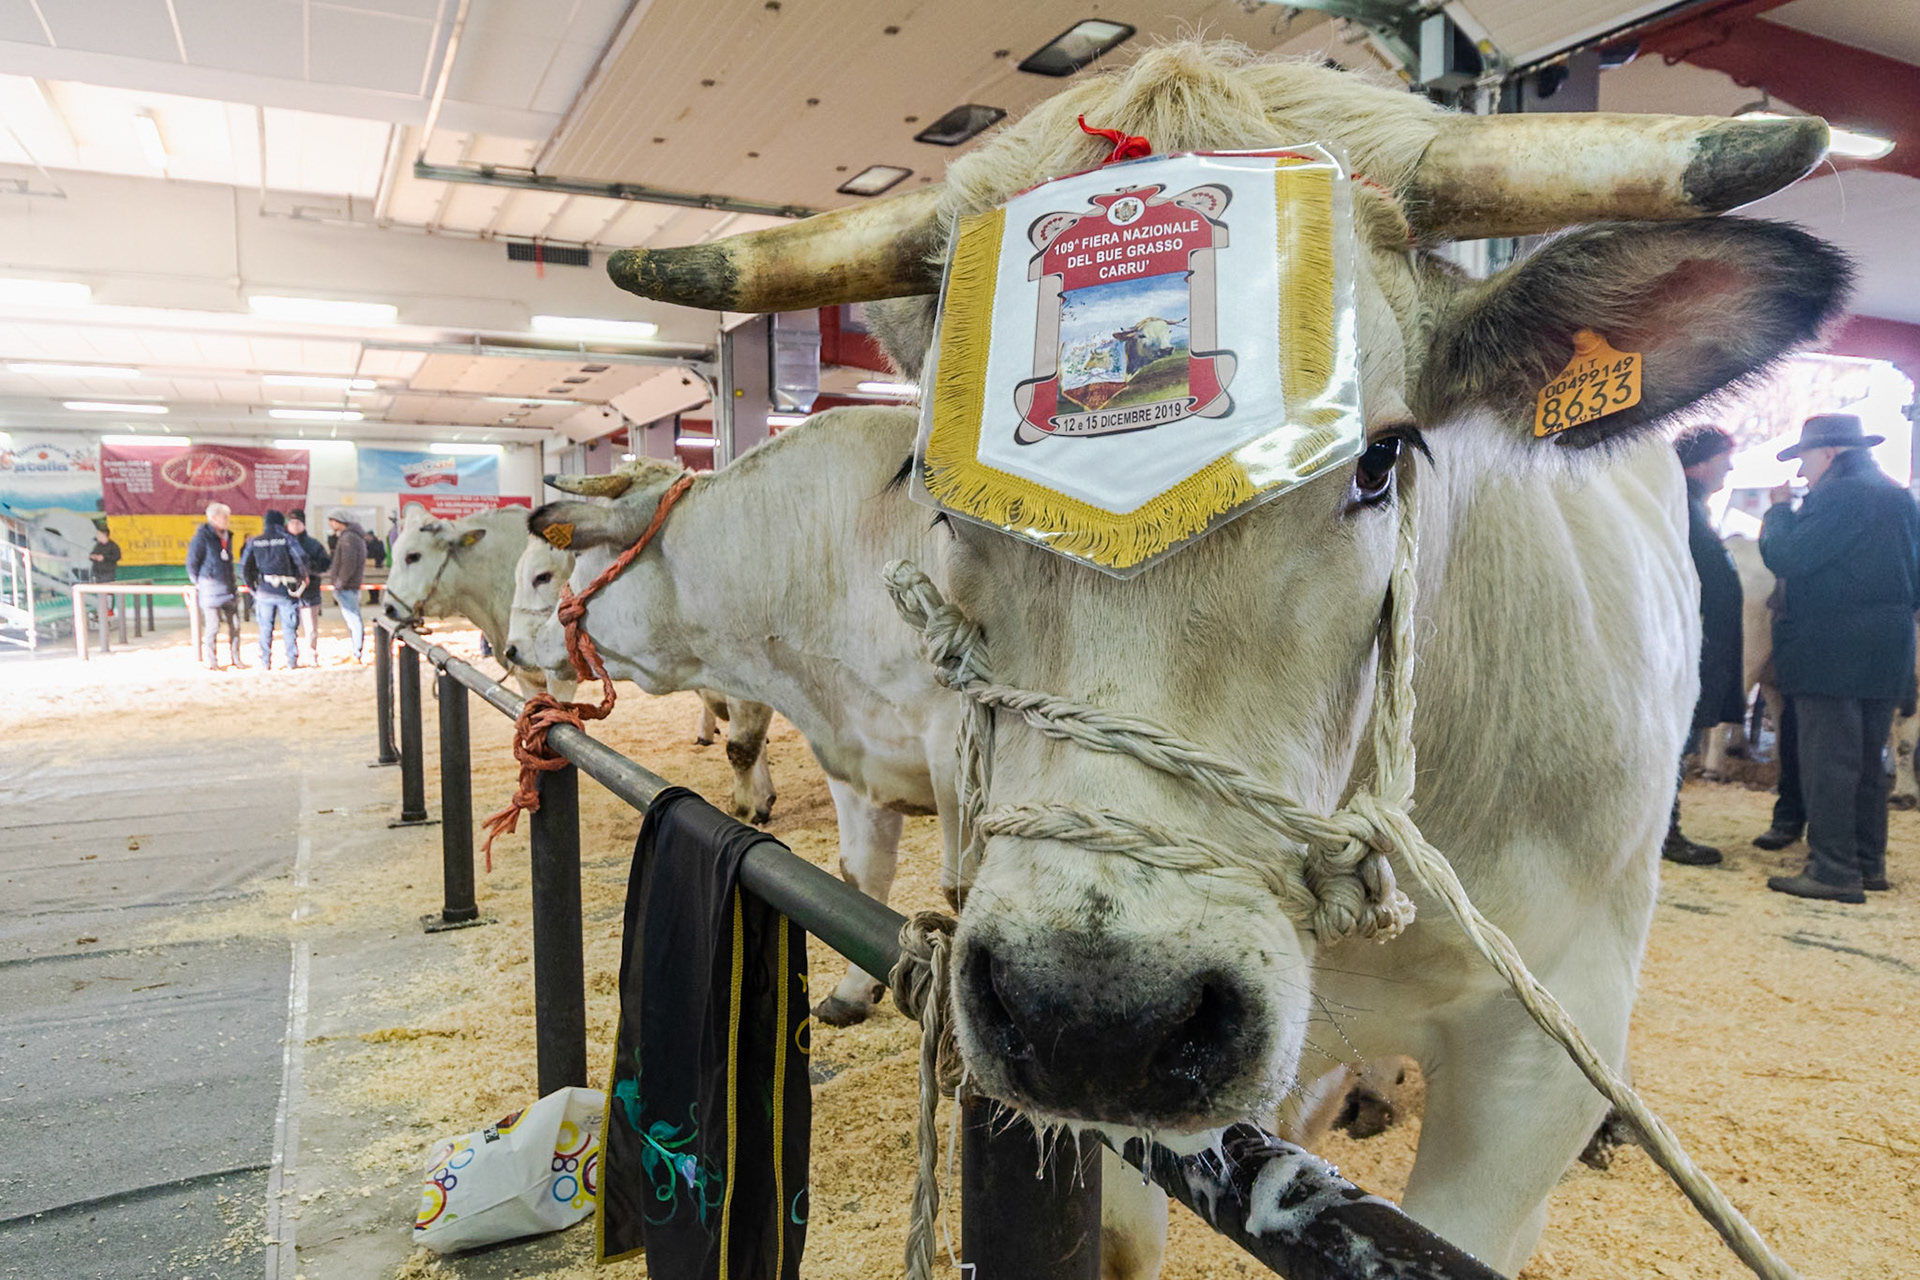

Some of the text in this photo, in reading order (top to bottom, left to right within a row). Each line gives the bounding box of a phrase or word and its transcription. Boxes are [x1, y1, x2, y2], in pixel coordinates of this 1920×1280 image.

[1081, 229, 1120, 250] FIERA
[1122, 219, 1200, 242] NAZIONALE
[1067, 237, 1184, 269] DEL BUE GRASSO
[1099, 259, 1150, 279] CARRU'
[1545, 356, 1634, 399] 00499149
[1541, 370, 1633, 428] 8633
[1063, 402, 1182, 432] 12 e 15 DICEMBRE 2019
